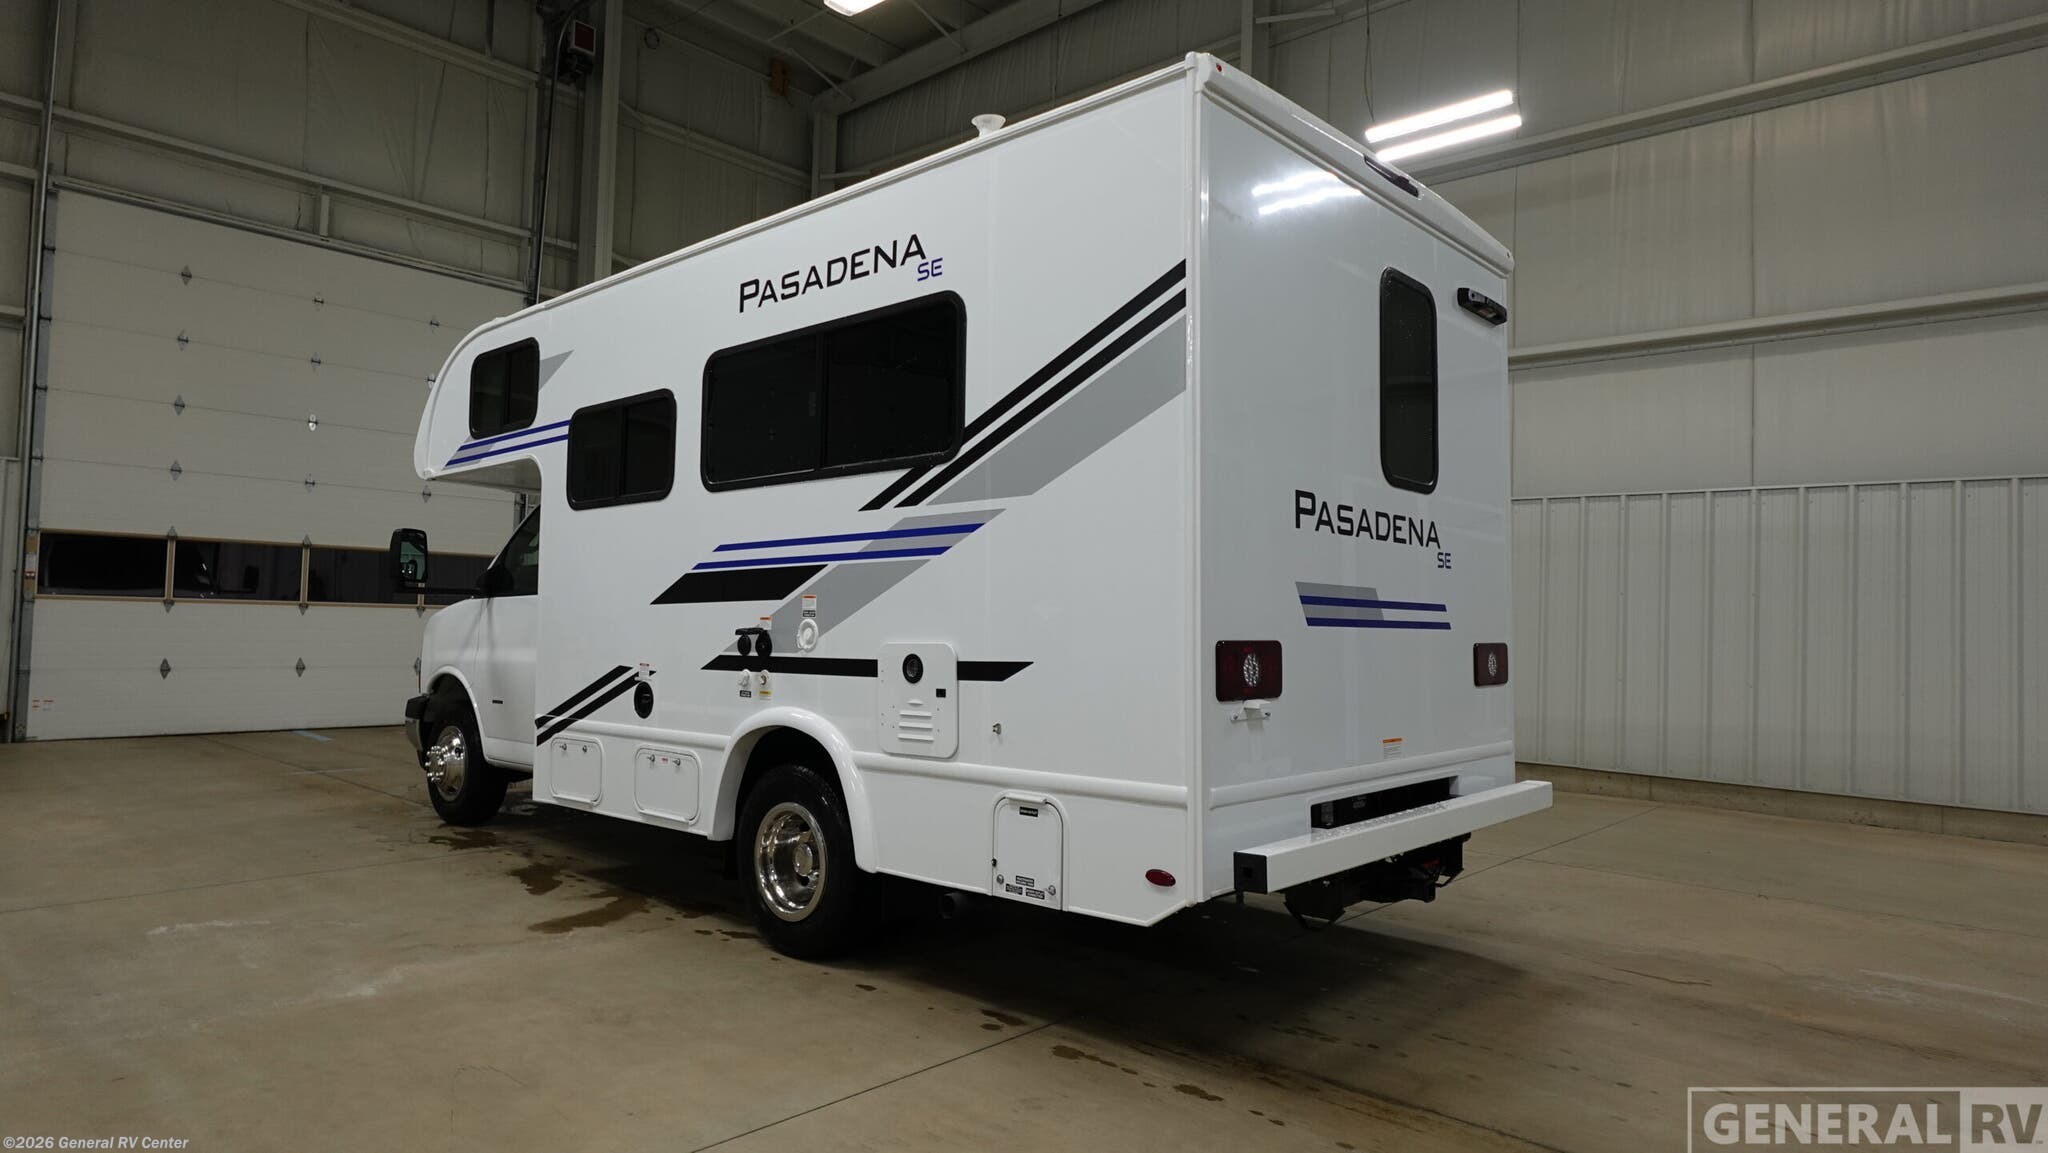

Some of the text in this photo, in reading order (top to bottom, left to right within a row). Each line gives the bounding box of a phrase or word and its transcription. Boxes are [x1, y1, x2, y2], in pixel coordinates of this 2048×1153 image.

[740, 233, 926, 313] PASADENA
[917, 257, 943, 281] SE
[1295, 489, 1441, 549] PASADENA
[1437, 552, 1452, 569] SE
